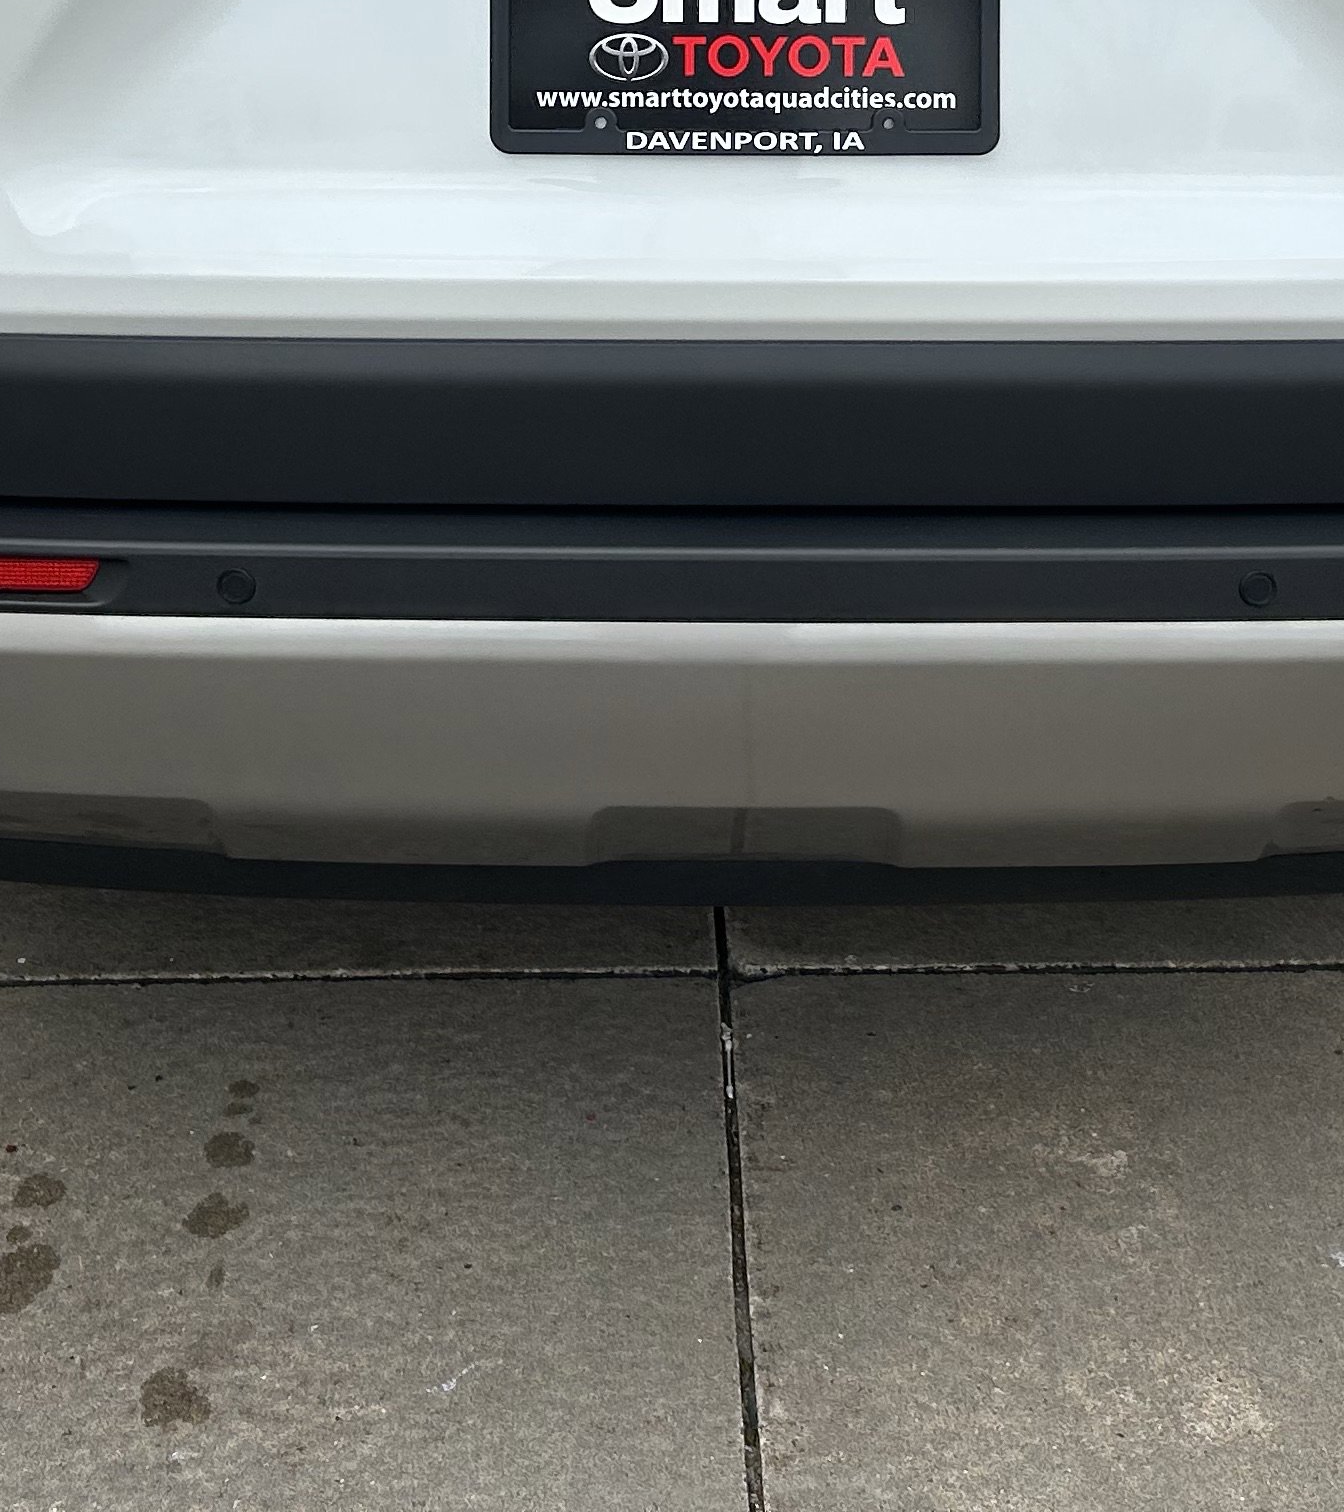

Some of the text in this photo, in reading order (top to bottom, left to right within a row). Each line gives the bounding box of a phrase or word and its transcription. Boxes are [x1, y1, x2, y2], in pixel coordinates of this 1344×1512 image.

[672, 34, 906, 78] TOYOTA
[535, 87, 957, 115] www.smarttoyotaquadcities.com
[625, 131, 866, 154] DAVENPORT, IA
